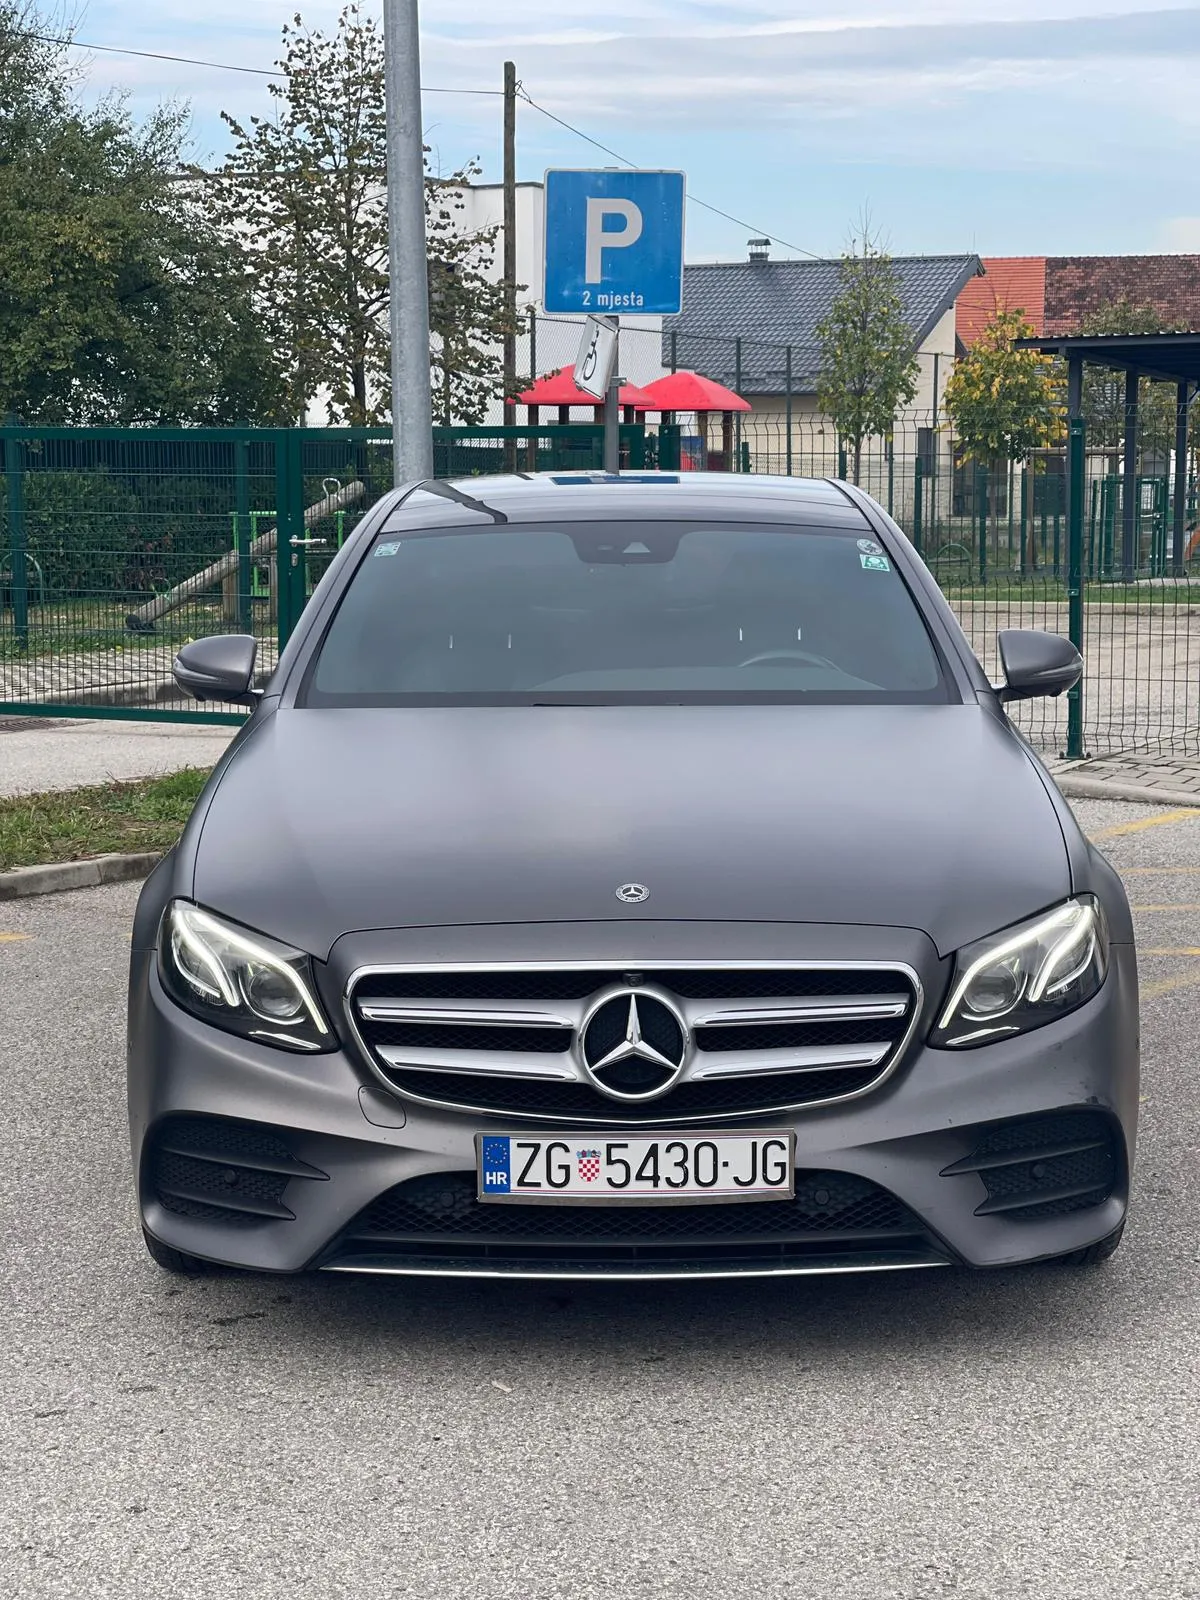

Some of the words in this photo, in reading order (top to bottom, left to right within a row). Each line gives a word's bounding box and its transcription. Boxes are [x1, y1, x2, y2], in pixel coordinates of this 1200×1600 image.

[585, 196, 643, 284] P
[582, 291, 591, 306] 2
[597, 291, 644, 309] mjesta
[485, 1172, 508, 1185] HR
[516, 1142, 571, 1189] ZG
